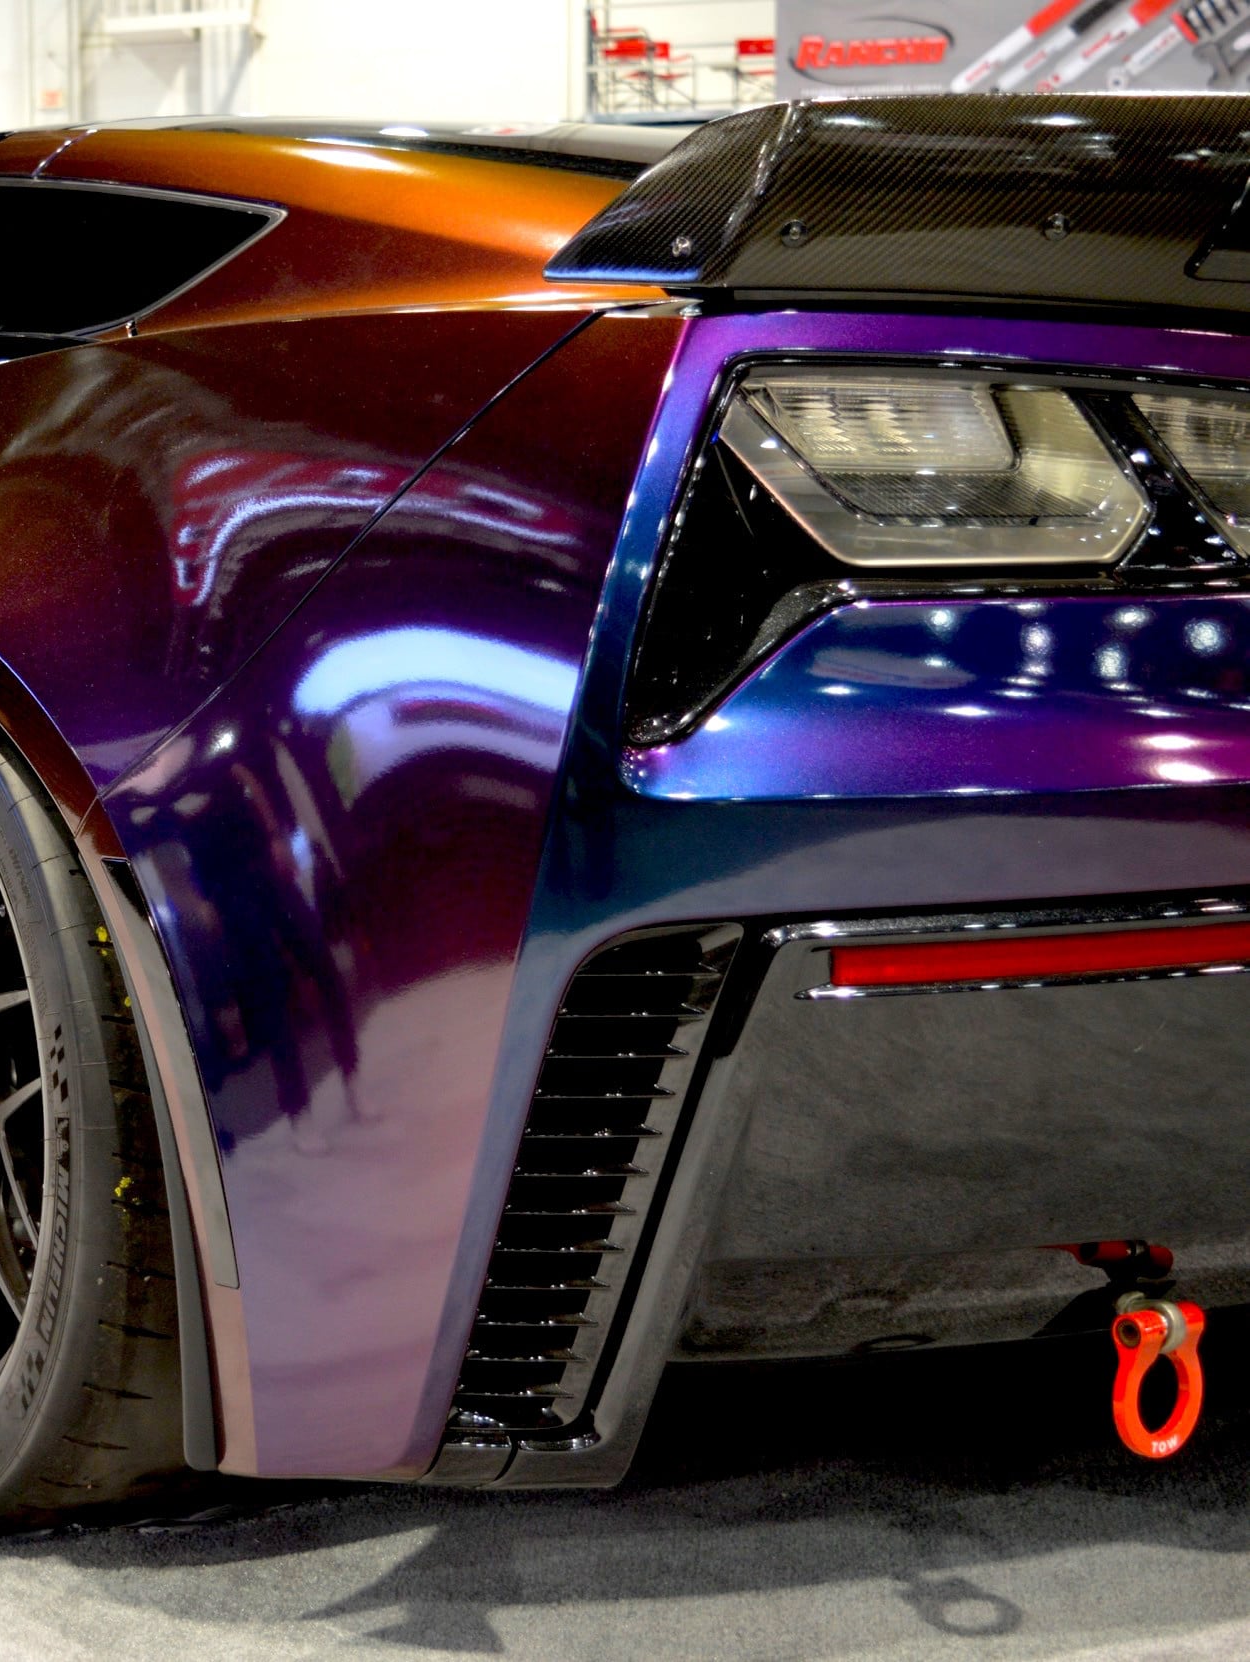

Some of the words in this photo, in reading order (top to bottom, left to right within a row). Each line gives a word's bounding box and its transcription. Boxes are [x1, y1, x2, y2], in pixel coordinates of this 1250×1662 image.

[796, 35, 947, 69] RANCHO
[37, 1172, 71, 1344] MICHELIN
[1151, 1434, 1178, 1454] TOW
